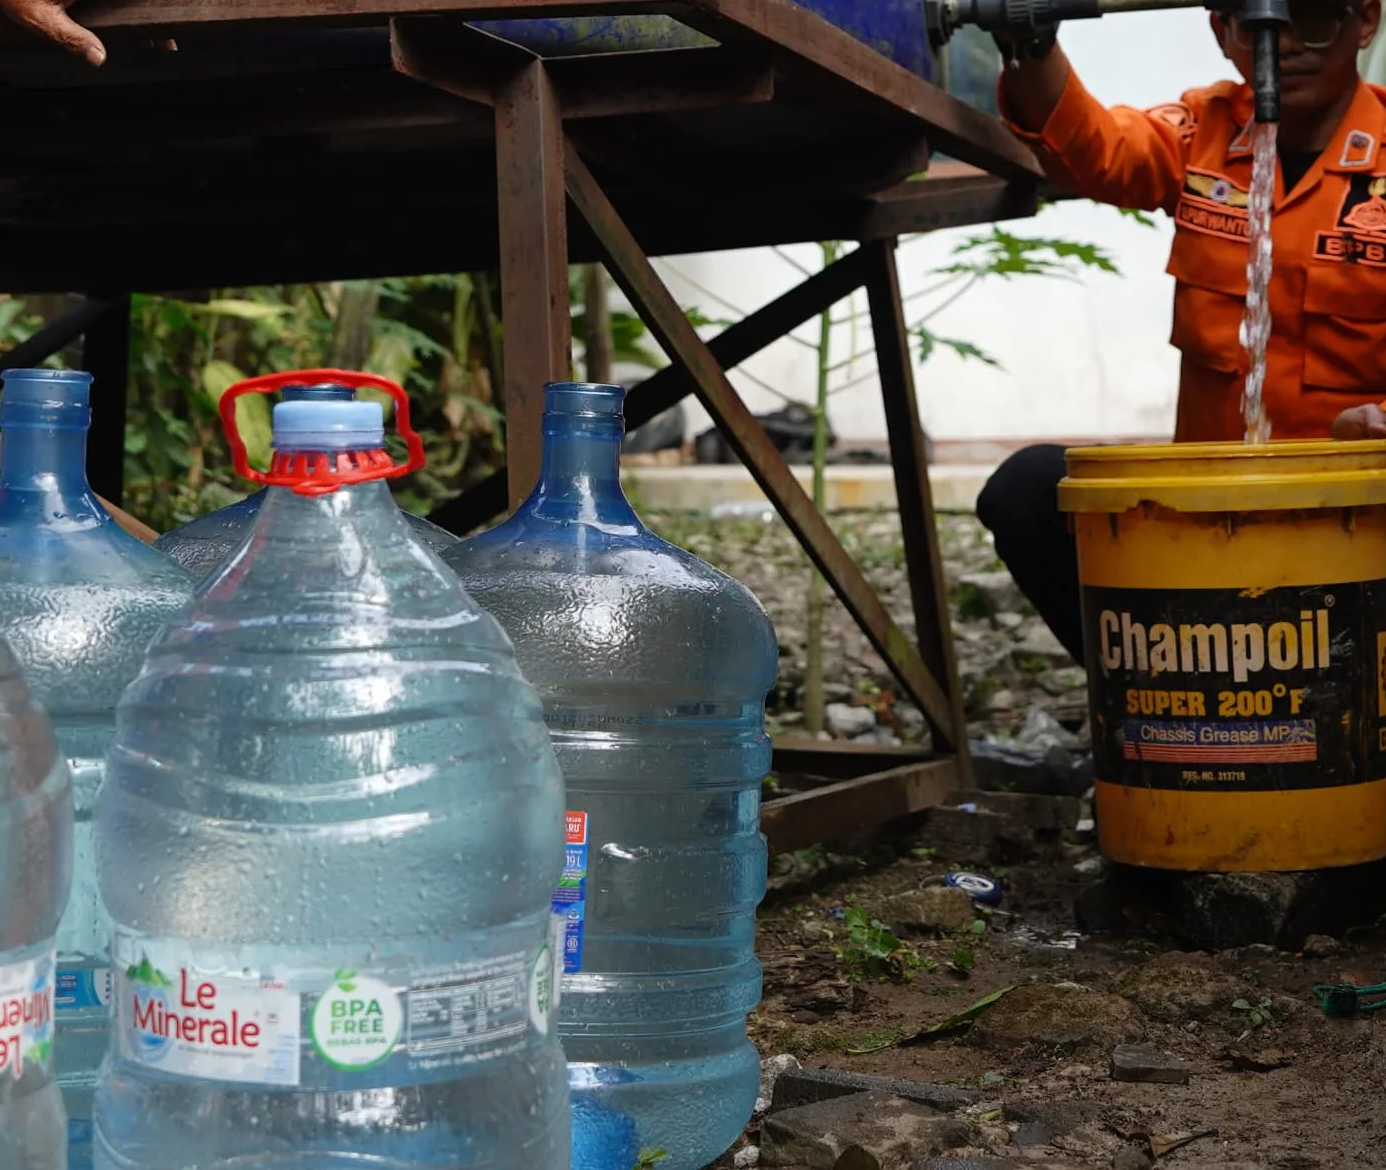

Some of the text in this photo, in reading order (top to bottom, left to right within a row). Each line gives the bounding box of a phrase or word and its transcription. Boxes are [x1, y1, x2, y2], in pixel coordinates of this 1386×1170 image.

[1099, 609, 1331, 682] Champoil
[1126, 688, 1206, 717] SUPER
[1140, 725, 1196, 742] Chassis
[1199, 727, 1259, 742] Grease
[180, 967, 217, 1010] Le
[133, 994, 261, 1048] Minerale
[330, 999, 384, 1018] BPA
[331, 1018, 384, 1035] FREE
